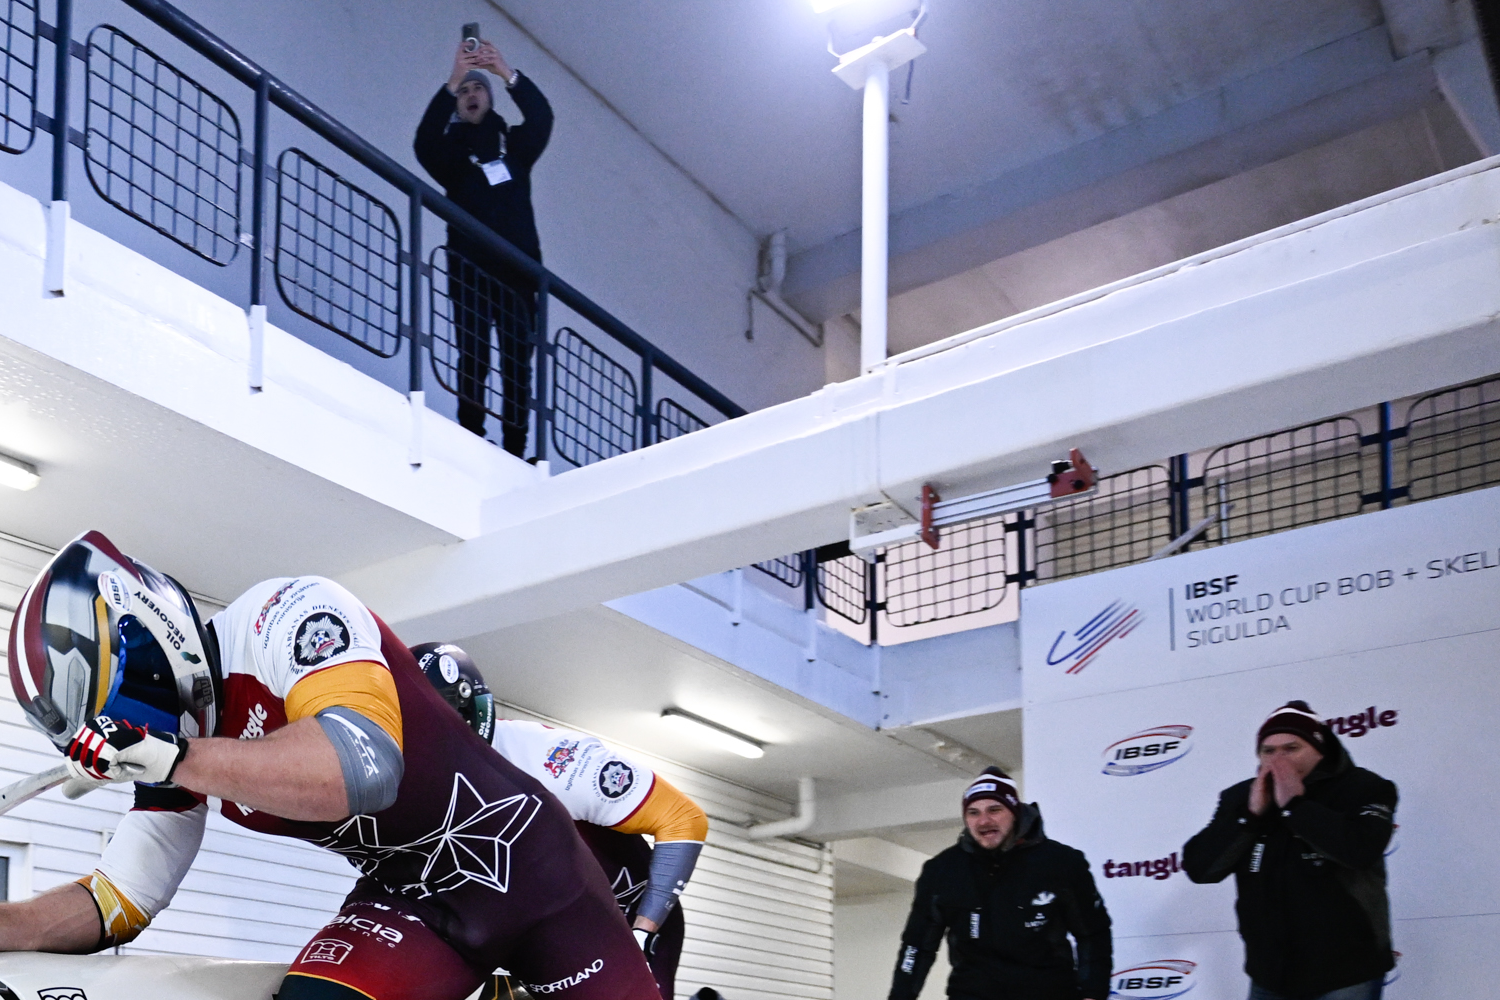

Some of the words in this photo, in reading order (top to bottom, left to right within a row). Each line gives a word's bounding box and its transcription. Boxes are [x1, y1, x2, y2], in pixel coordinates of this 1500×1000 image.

[110, 578, 122, 605] IBSF
[1186, 593, 1275, 624] WORLD
[1279, 581, 1331, 607] CUP
[1337, 569, 1395, 596] BOB
[1401, 567, 1419, 580] +
[1426, 547, 1500, 579] SKEL
[1186, 574, 1239, 600] IBSF
[133, 590, 186, 643] RECOVERY
[166, 633, 181, 650] OIL
[1186, 615, 1292, 649] SIGULDA
[238, 703, 268, 740] ngle
[478, 721, 486, 736] OIL
[1325, 706, 1398, 737] ngle
[1115, 741, 1180, 760] IBSF
[1103, 852, 1184, 880] tangl
[329, 914, 404, 943] alcia
[529, 959, 604, 994] SPORTLAND
[1118, 976, 1183, 990] IBSF
